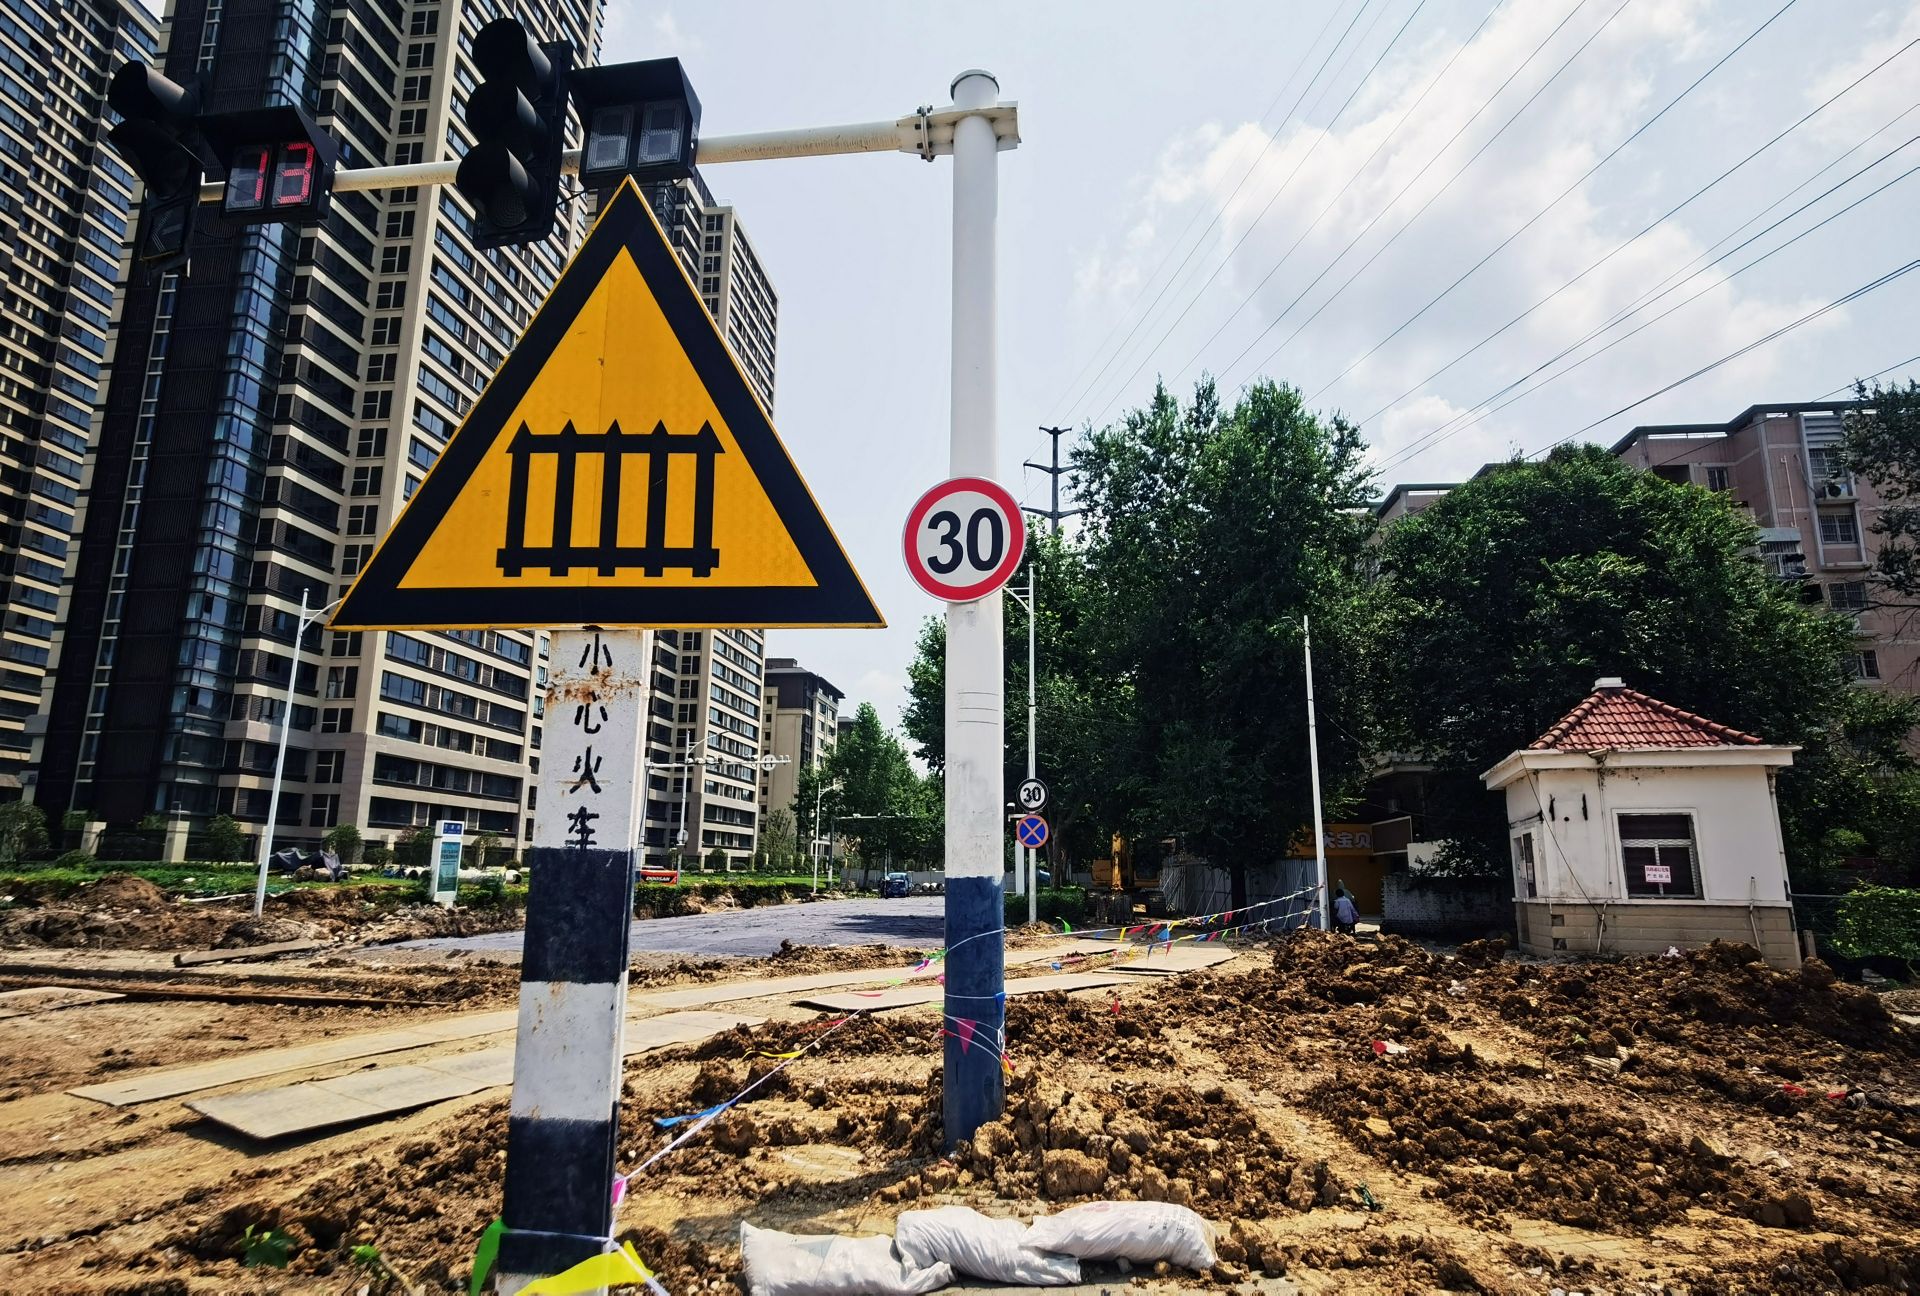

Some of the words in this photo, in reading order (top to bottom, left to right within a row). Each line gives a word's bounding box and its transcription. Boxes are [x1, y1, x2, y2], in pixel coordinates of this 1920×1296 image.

[254, 143, 315, 204] 13
[927, 507, 1004, 574] 30
[1023, 787, 1042, 802] 30
